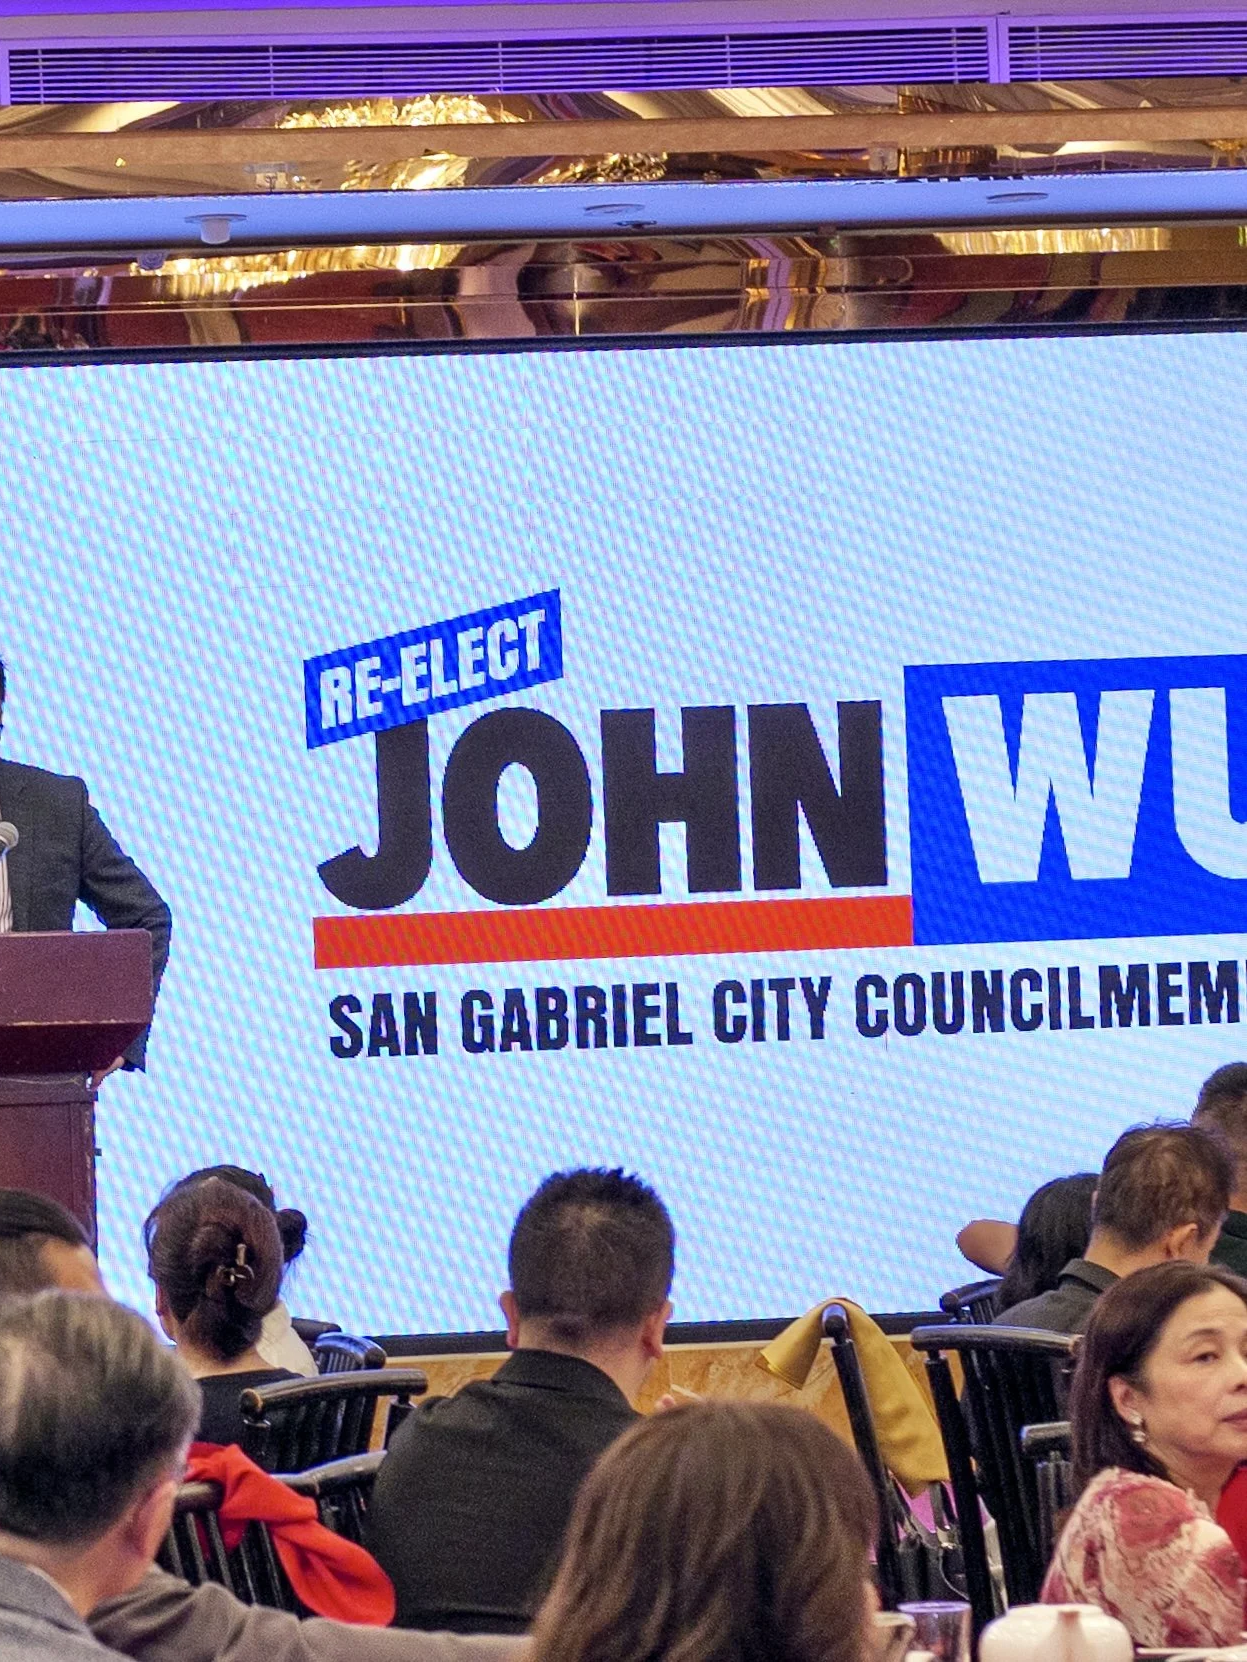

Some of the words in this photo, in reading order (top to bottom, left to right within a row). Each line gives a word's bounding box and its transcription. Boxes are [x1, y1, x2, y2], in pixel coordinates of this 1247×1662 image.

[320, 609, 546, 730] RE-ELECT
[317, 700, 887, 910] JOHN
[941, 687, 1247, 884] WU
[328, 991, 439, 1059] SAN
[461, 982, 693, 1054] GABRIEL
[713, 976, 832, 1043] CITY
[854, 959, 1247, 1038] COUNCILMEM
